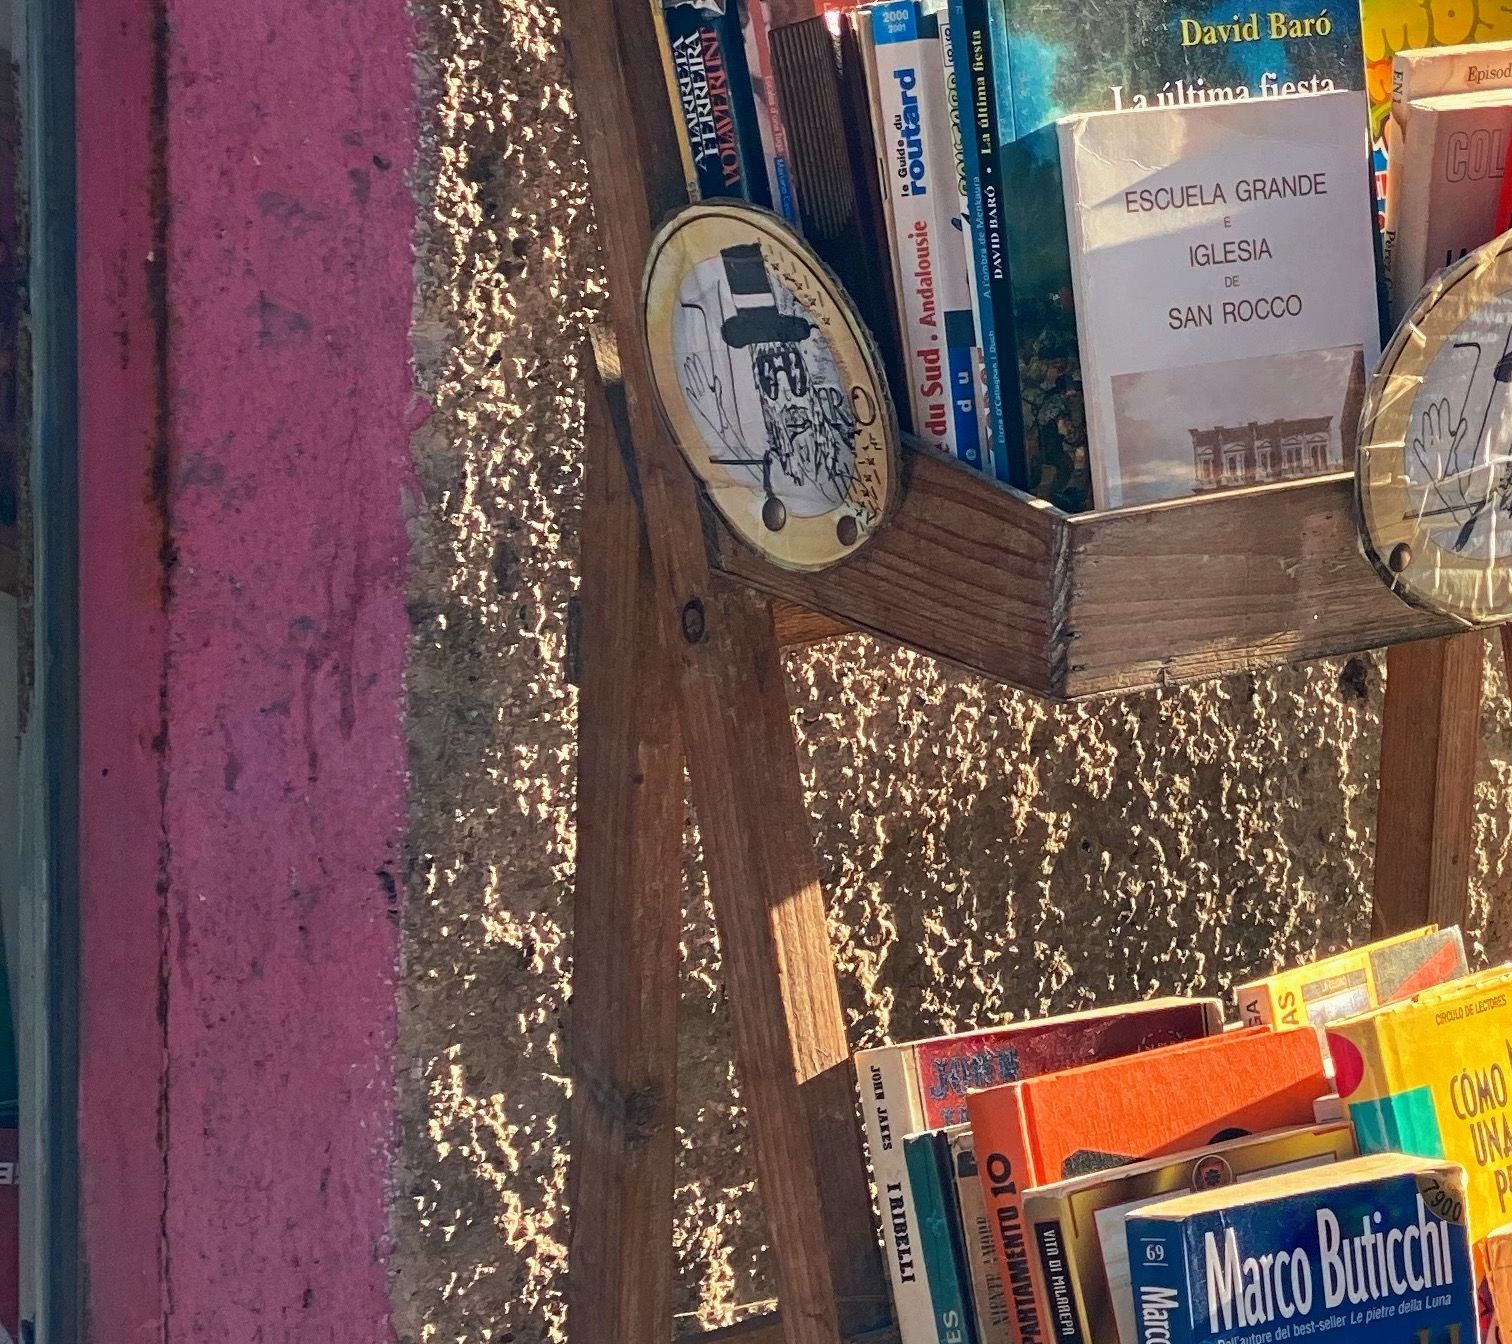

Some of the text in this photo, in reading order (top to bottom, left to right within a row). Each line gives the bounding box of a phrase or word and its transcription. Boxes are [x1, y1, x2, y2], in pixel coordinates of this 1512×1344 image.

[882, 8, 909, 24] 2000
[1180, 8, 1333, 48] David Baró
[971, 29, 992, 156] La última fiesta
[1155, 77, 1250, 108] última
[1258, 71, 1336, 98] fiesta
[893, 67, 927, 197] routard
[893, 113, 910, 197] le Guide du
[1125, 172, 1328, 214] ESCUELA GRANDE
[983, 184, 1005, 280] DAVID BARÓ
[1222, 215, 1232, 229] E
[908, 220, 937, 327] Andalousie
[1189, 237, 1273, 268] IGLESIA
[1224, 275, 1240, 289] DE
[1167, 293, 1303, 330] SAN ROCCO
[917, 347, 945, 400] Sud
[924, 402, 948, 437] du
[869, 1064, 893, 1152] JOHN JAKES
[1449, 1063, 1509, 1121] CÓMO
[1421, 1176, 1463, 1223] 7900
[887, 1197, 916, 1285] RIBELLI
[1145, 1243, 1164, 1262] 69
[1203, 1192, 1454, 1335] Marco Buticchi
[1042, 1228, 1075, 1336] VITA DI MILAREPA
[1274, 1325, 1292, 1342] del
[1292, 1315, 1347, 1339] best-seller
[1350, 1310, 1365, 1326] Le
[1365, 1305, 1396, 1325] pietre
[1397, 1299, 1423, 1316] della
[1424, 1293, 1452, 1309] Luna
